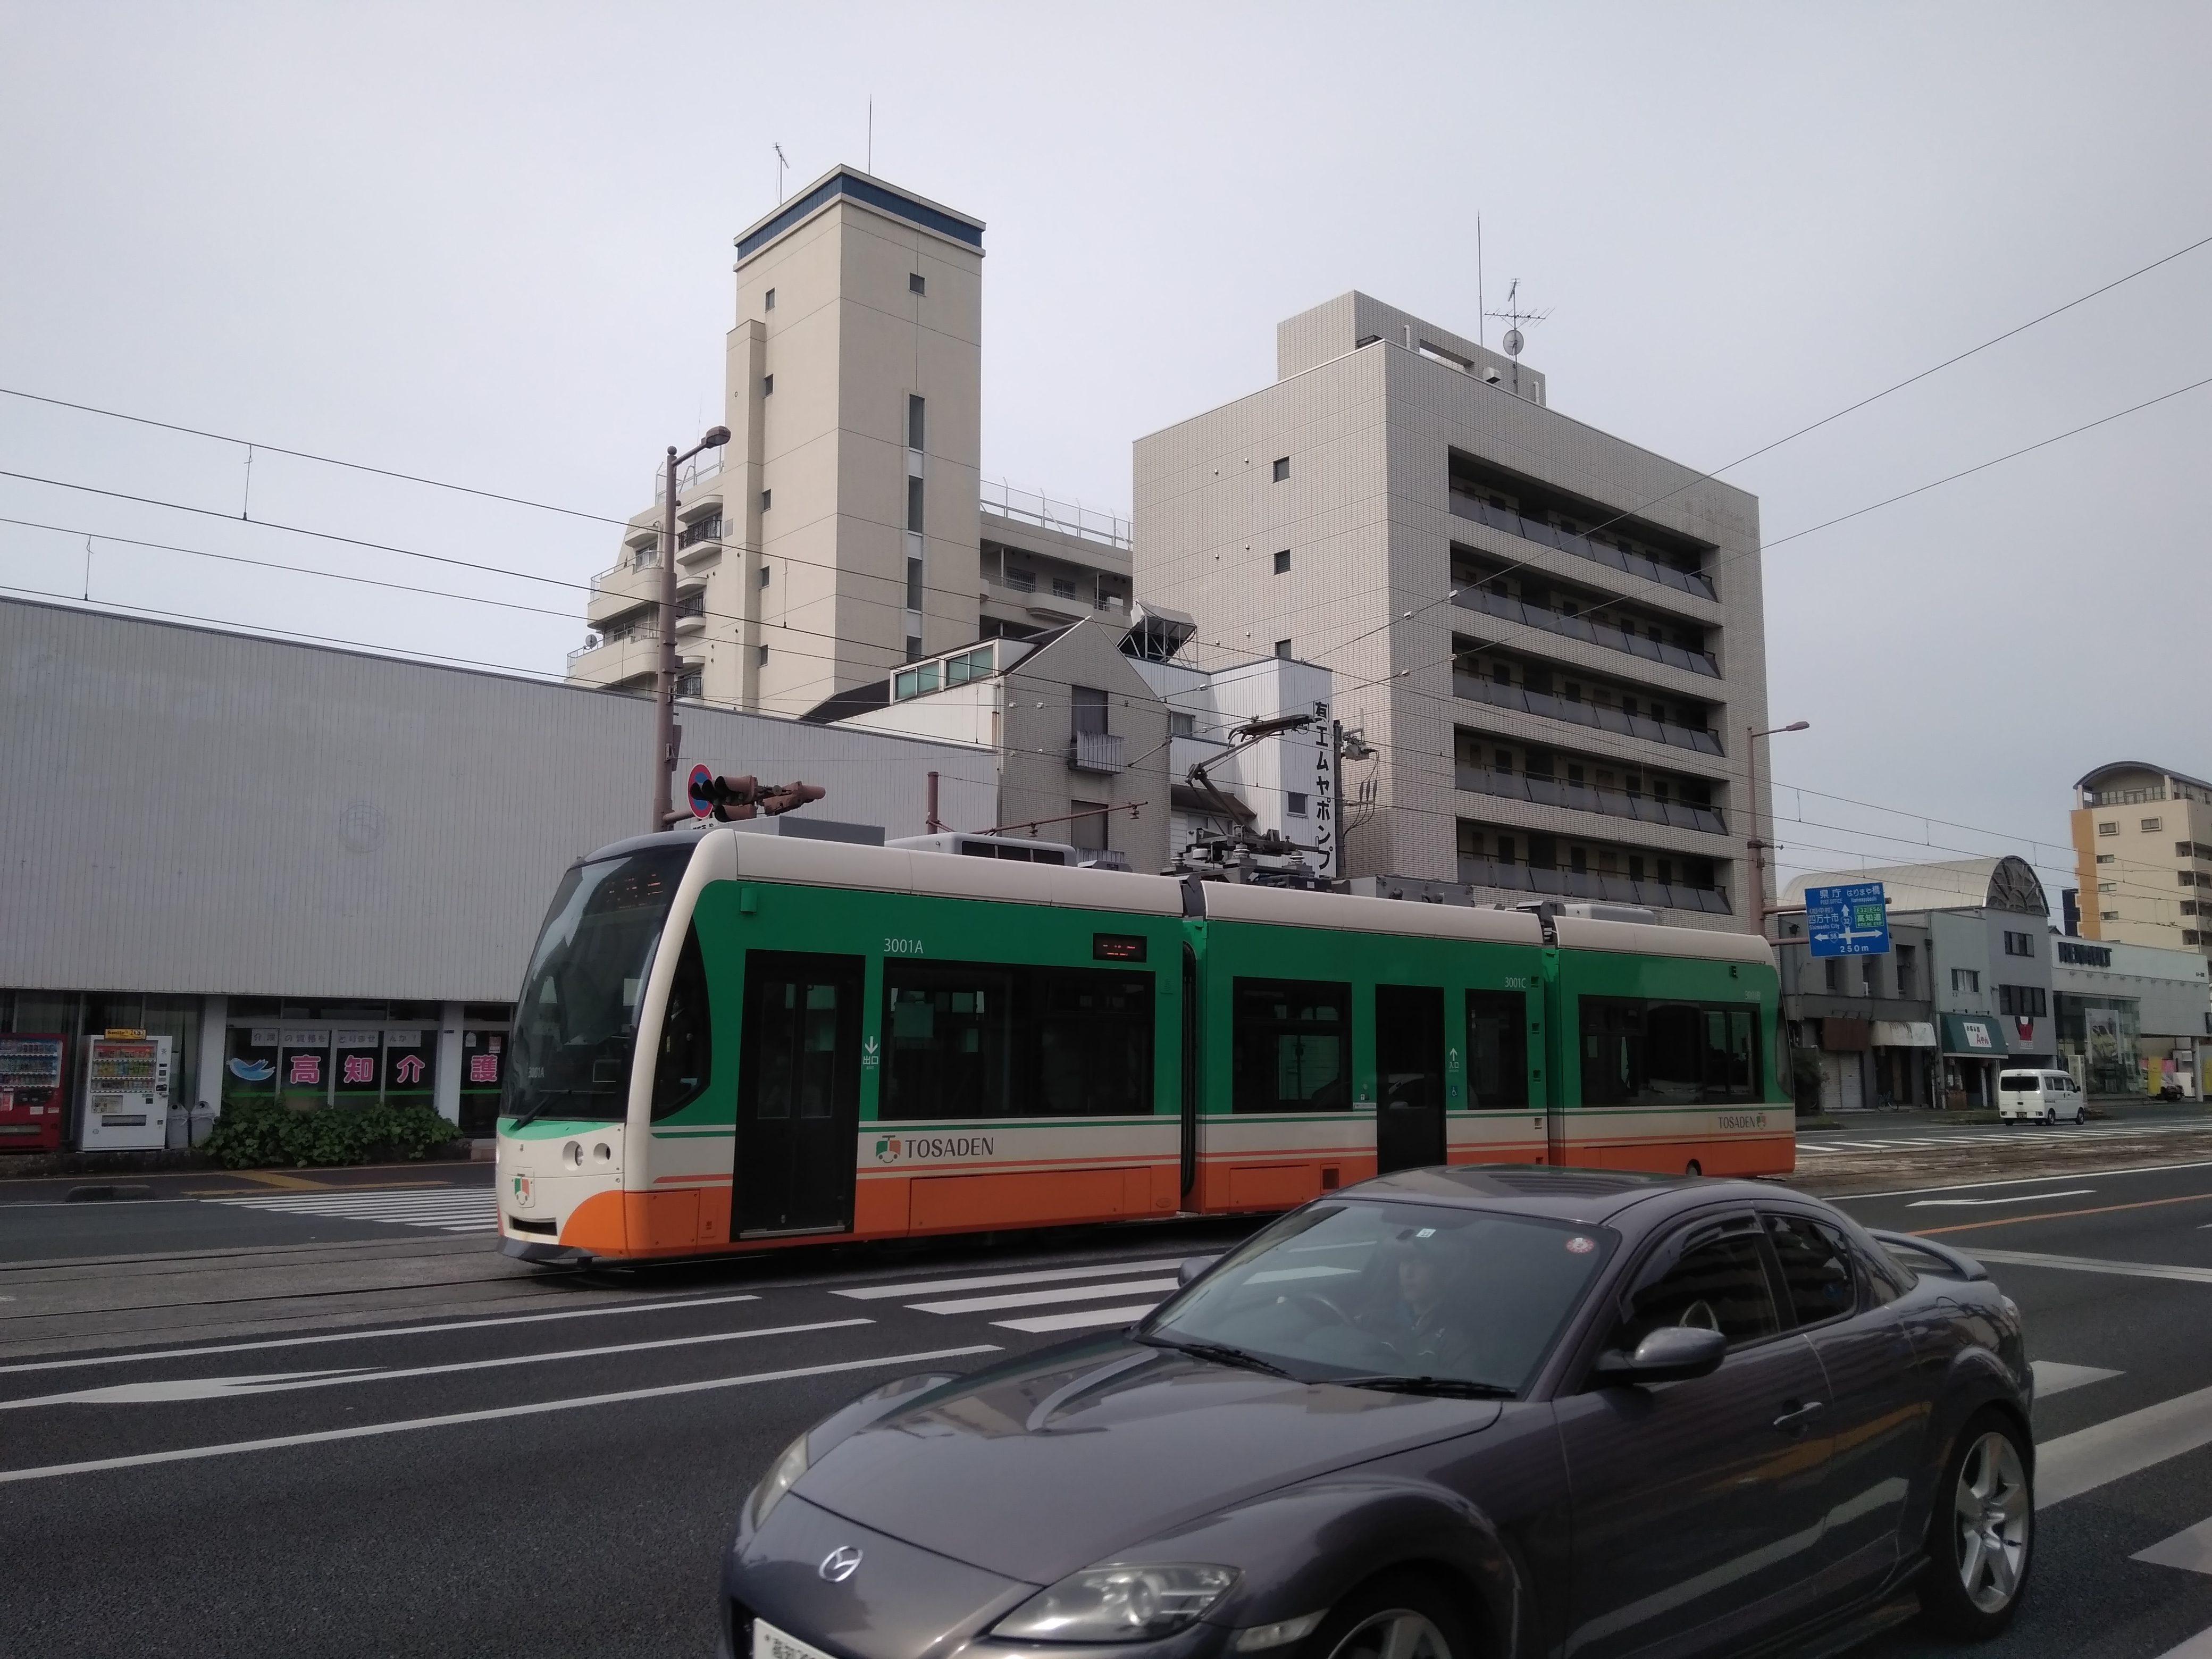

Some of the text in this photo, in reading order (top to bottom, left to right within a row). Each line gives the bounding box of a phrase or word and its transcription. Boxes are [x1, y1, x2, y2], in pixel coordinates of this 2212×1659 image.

[1820, 889, 1842, 899] 県庁
[1847, 885, 1880, 897] はりまや橋
[1808, 913, 1839, 924] 四万十市
[1857, 913, 1882, 923] 高知道
[884, 938, 924, 954] 3001A
[1505, 977, 1526, 988] 3001C
[1745, 990, 1761, 1001] 3001B
[862, 1055, 879, 1065] 出口
[528, 1067, 544, 1078] 3001A
[1718, 1116, 1756, 1129] TOSADEN
[905, 1137, 994, 1159] TOSADEN
